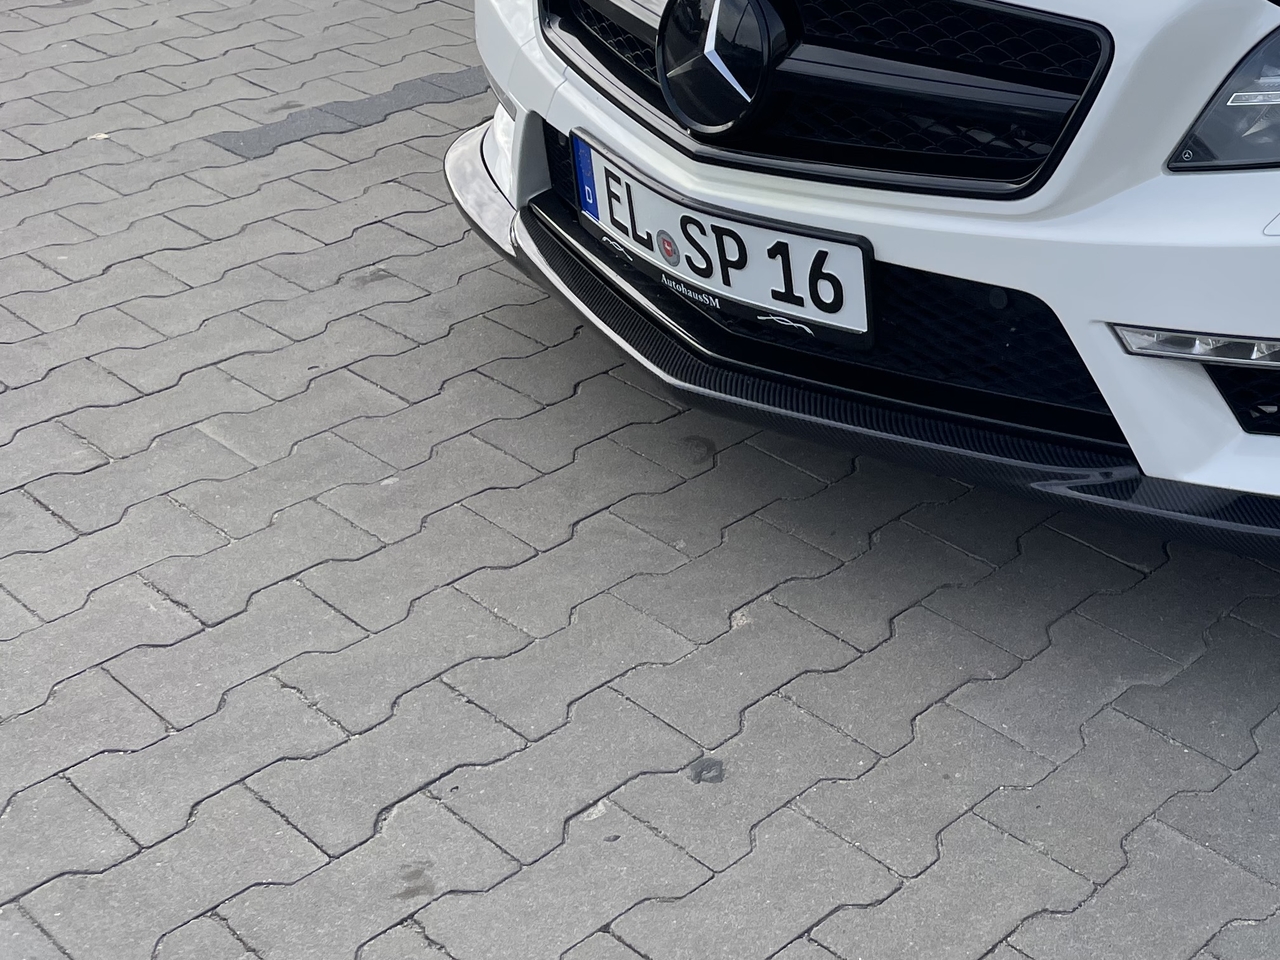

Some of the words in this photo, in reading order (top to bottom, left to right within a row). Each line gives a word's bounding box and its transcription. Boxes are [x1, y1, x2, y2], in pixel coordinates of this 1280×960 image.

[585, 185, 593, 204] D
[604, 166, 654, 252] EL
[680, 214, 748, 287] SP
[767, 240, 844, 314] 16
[661, 273, 721, 310] AutohausSM
